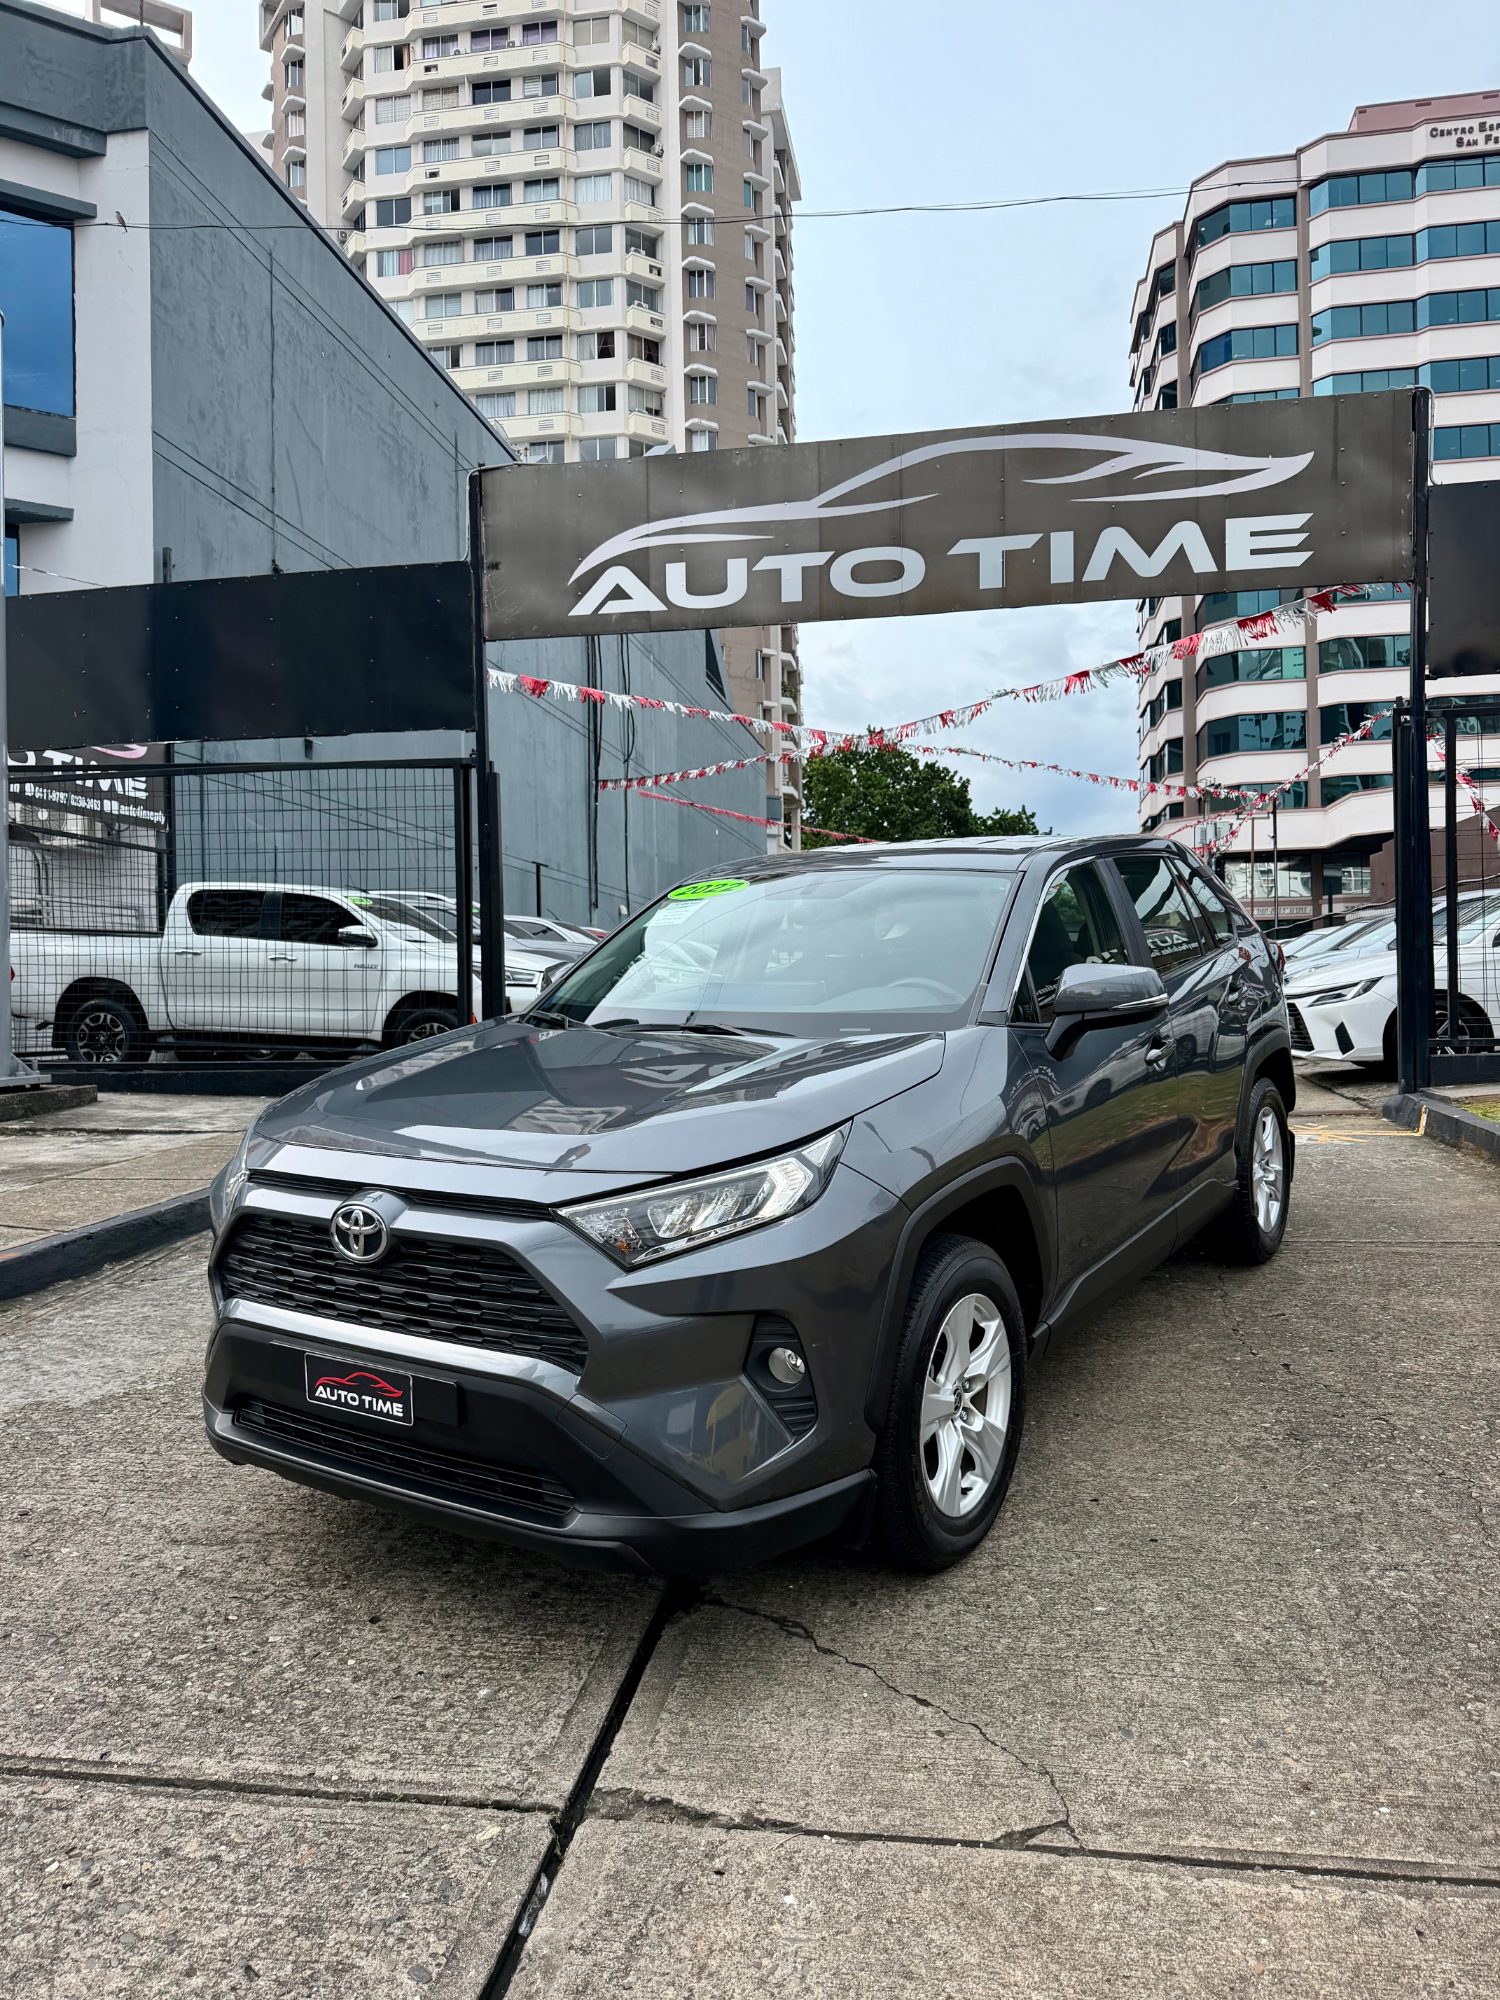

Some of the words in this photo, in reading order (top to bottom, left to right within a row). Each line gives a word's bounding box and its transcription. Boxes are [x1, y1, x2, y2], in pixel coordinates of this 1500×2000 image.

[1430, 126, 1474, 138] CENTRO
[1456, 137, 1478, 147] SAN
[568, 546, 926, 617] AUTO
[946, 513, 1316, 591] TIME
[314, 1385, 360, 1406] AUTO
[361, 1395, 404, 1417] TIME
